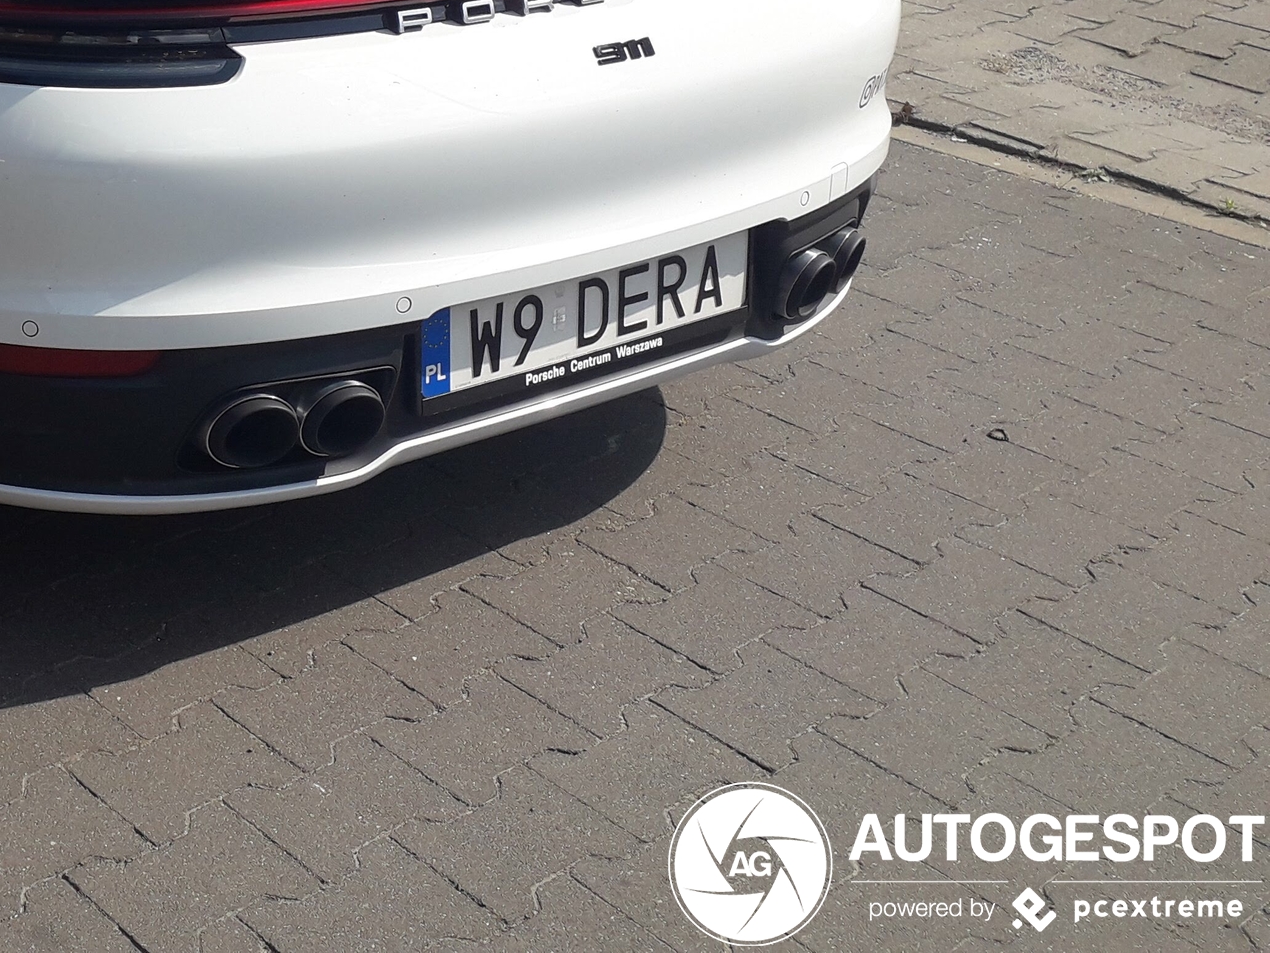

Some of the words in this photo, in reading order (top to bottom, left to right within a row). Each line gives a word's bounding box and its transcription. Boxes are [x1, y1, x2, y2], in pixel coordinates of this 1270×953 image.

[592, 36, 656, 66] 911
[470, 294, 544, 379] W9
[577, 244, 723, 349] DERA
[425, 363, 447, 385] PL
[525, 365, 565, 387] Porsche
[570, 351, 611, 373] Centrum
[616, 336, 664, 359] Warszawa
